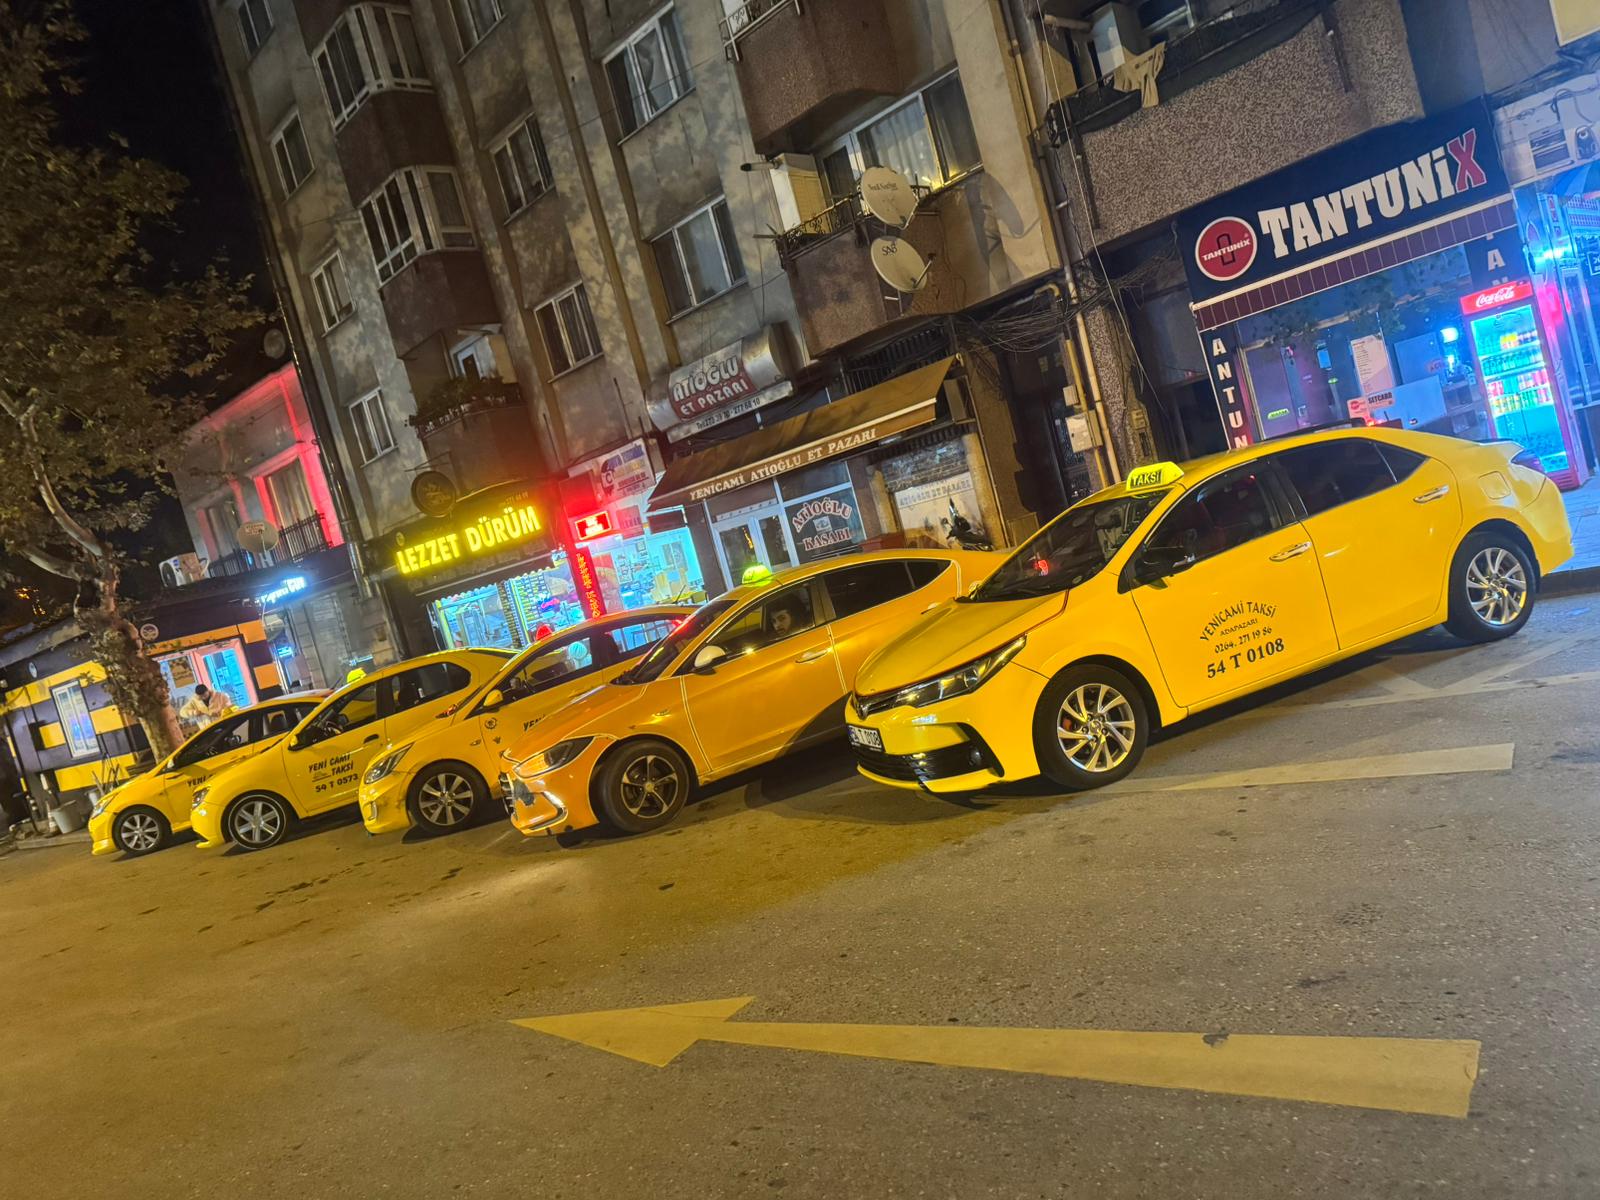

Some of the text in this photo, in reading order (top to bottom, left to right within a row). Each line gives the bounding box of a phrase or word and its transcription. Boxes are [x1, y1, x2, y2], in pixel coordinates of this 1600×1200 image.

[681, 404, 695, 415] ET
[808, 448, 824, 462] ET
[828, 428, 877, 455] PAZARI
[792, 497, 852, 533] ATİOĞLU
[396, 533, 461, 575] LEZZET
[465, 506, 542, 553] DÜRÜM
[802, 527, 851, 551] KASABI
[1207, 638, 1284, 678] 54 T 0108
